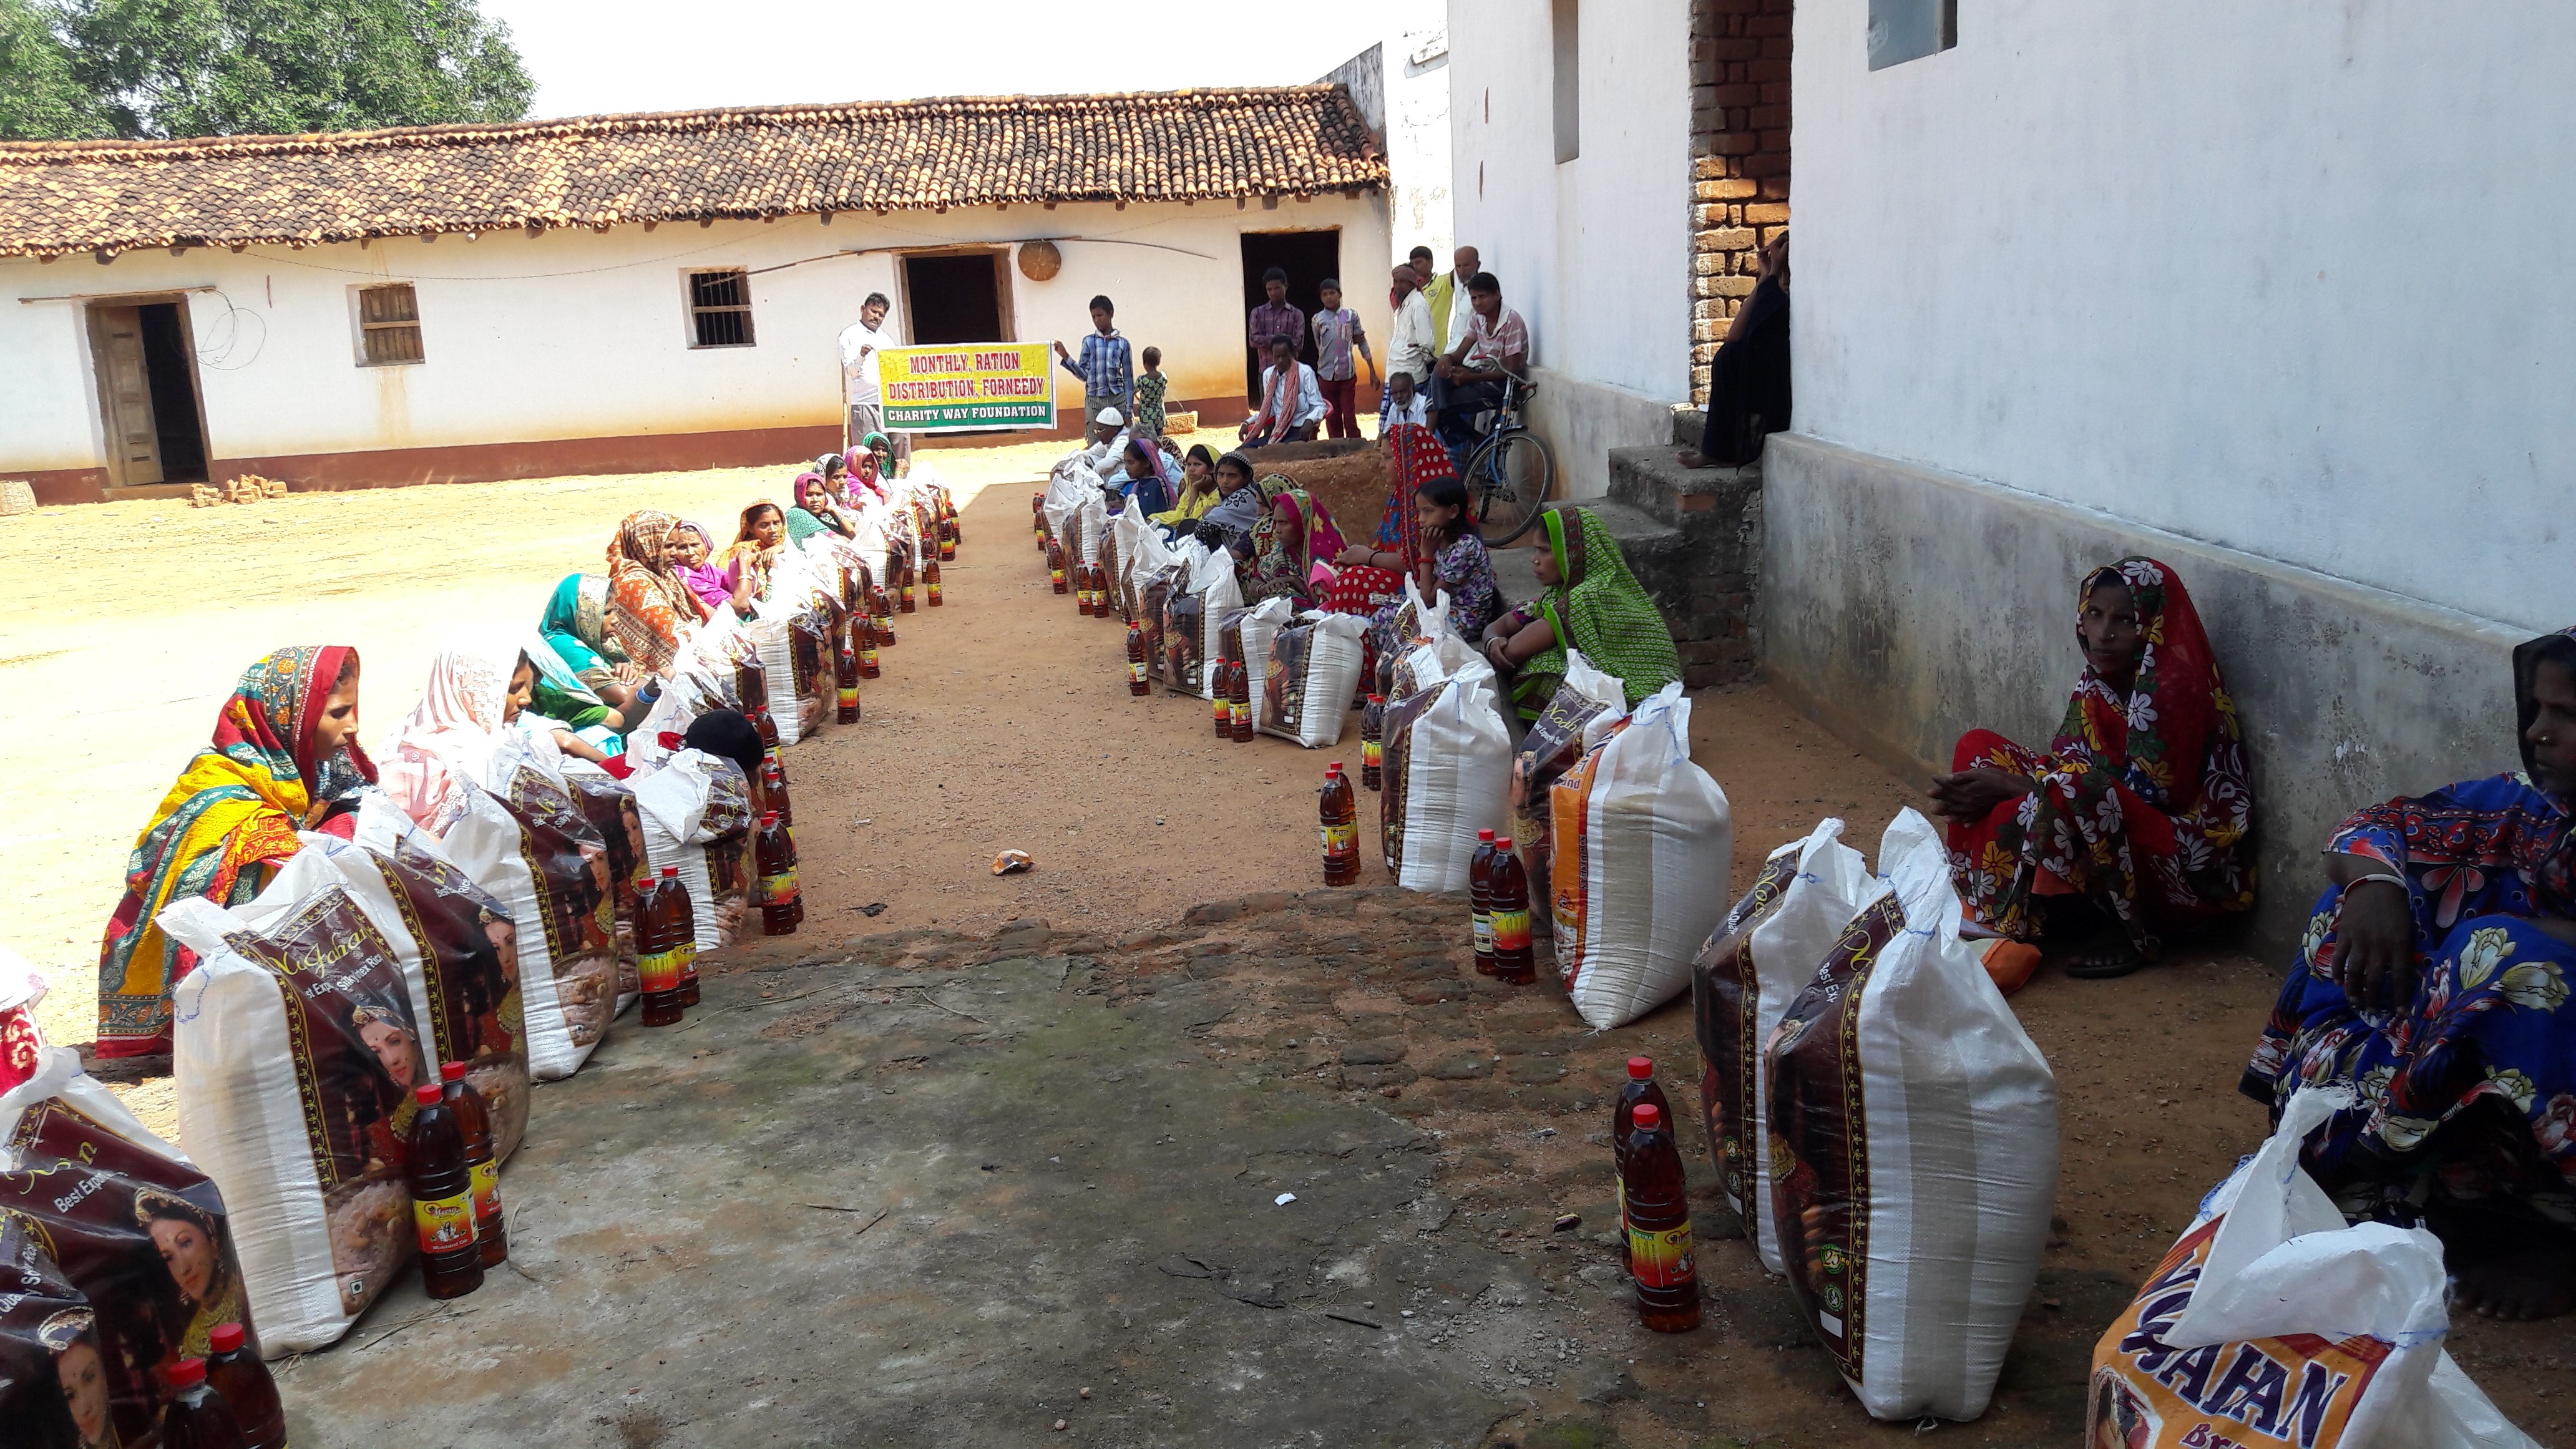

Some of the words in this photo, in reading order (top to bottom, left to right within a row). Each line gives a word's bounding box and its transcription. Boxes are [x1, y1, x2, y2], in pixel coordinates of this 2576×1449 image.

[909, 354, 972, 374] MONTHLY,
[975, 352, 1020, 371] RATION
[888, 379, 980, 401] DISTRIBUTION,
[982, 377, 1045, 397] FORNEEDY
[887, 409, 940, 421] CHARITY
[943, 407, 968, 419] WAY
[971, 405, 1046, 419] FOUNDATION
[53, 1187, 85, 1214] Best
[1824, 1249, 1841, 1266] 25
